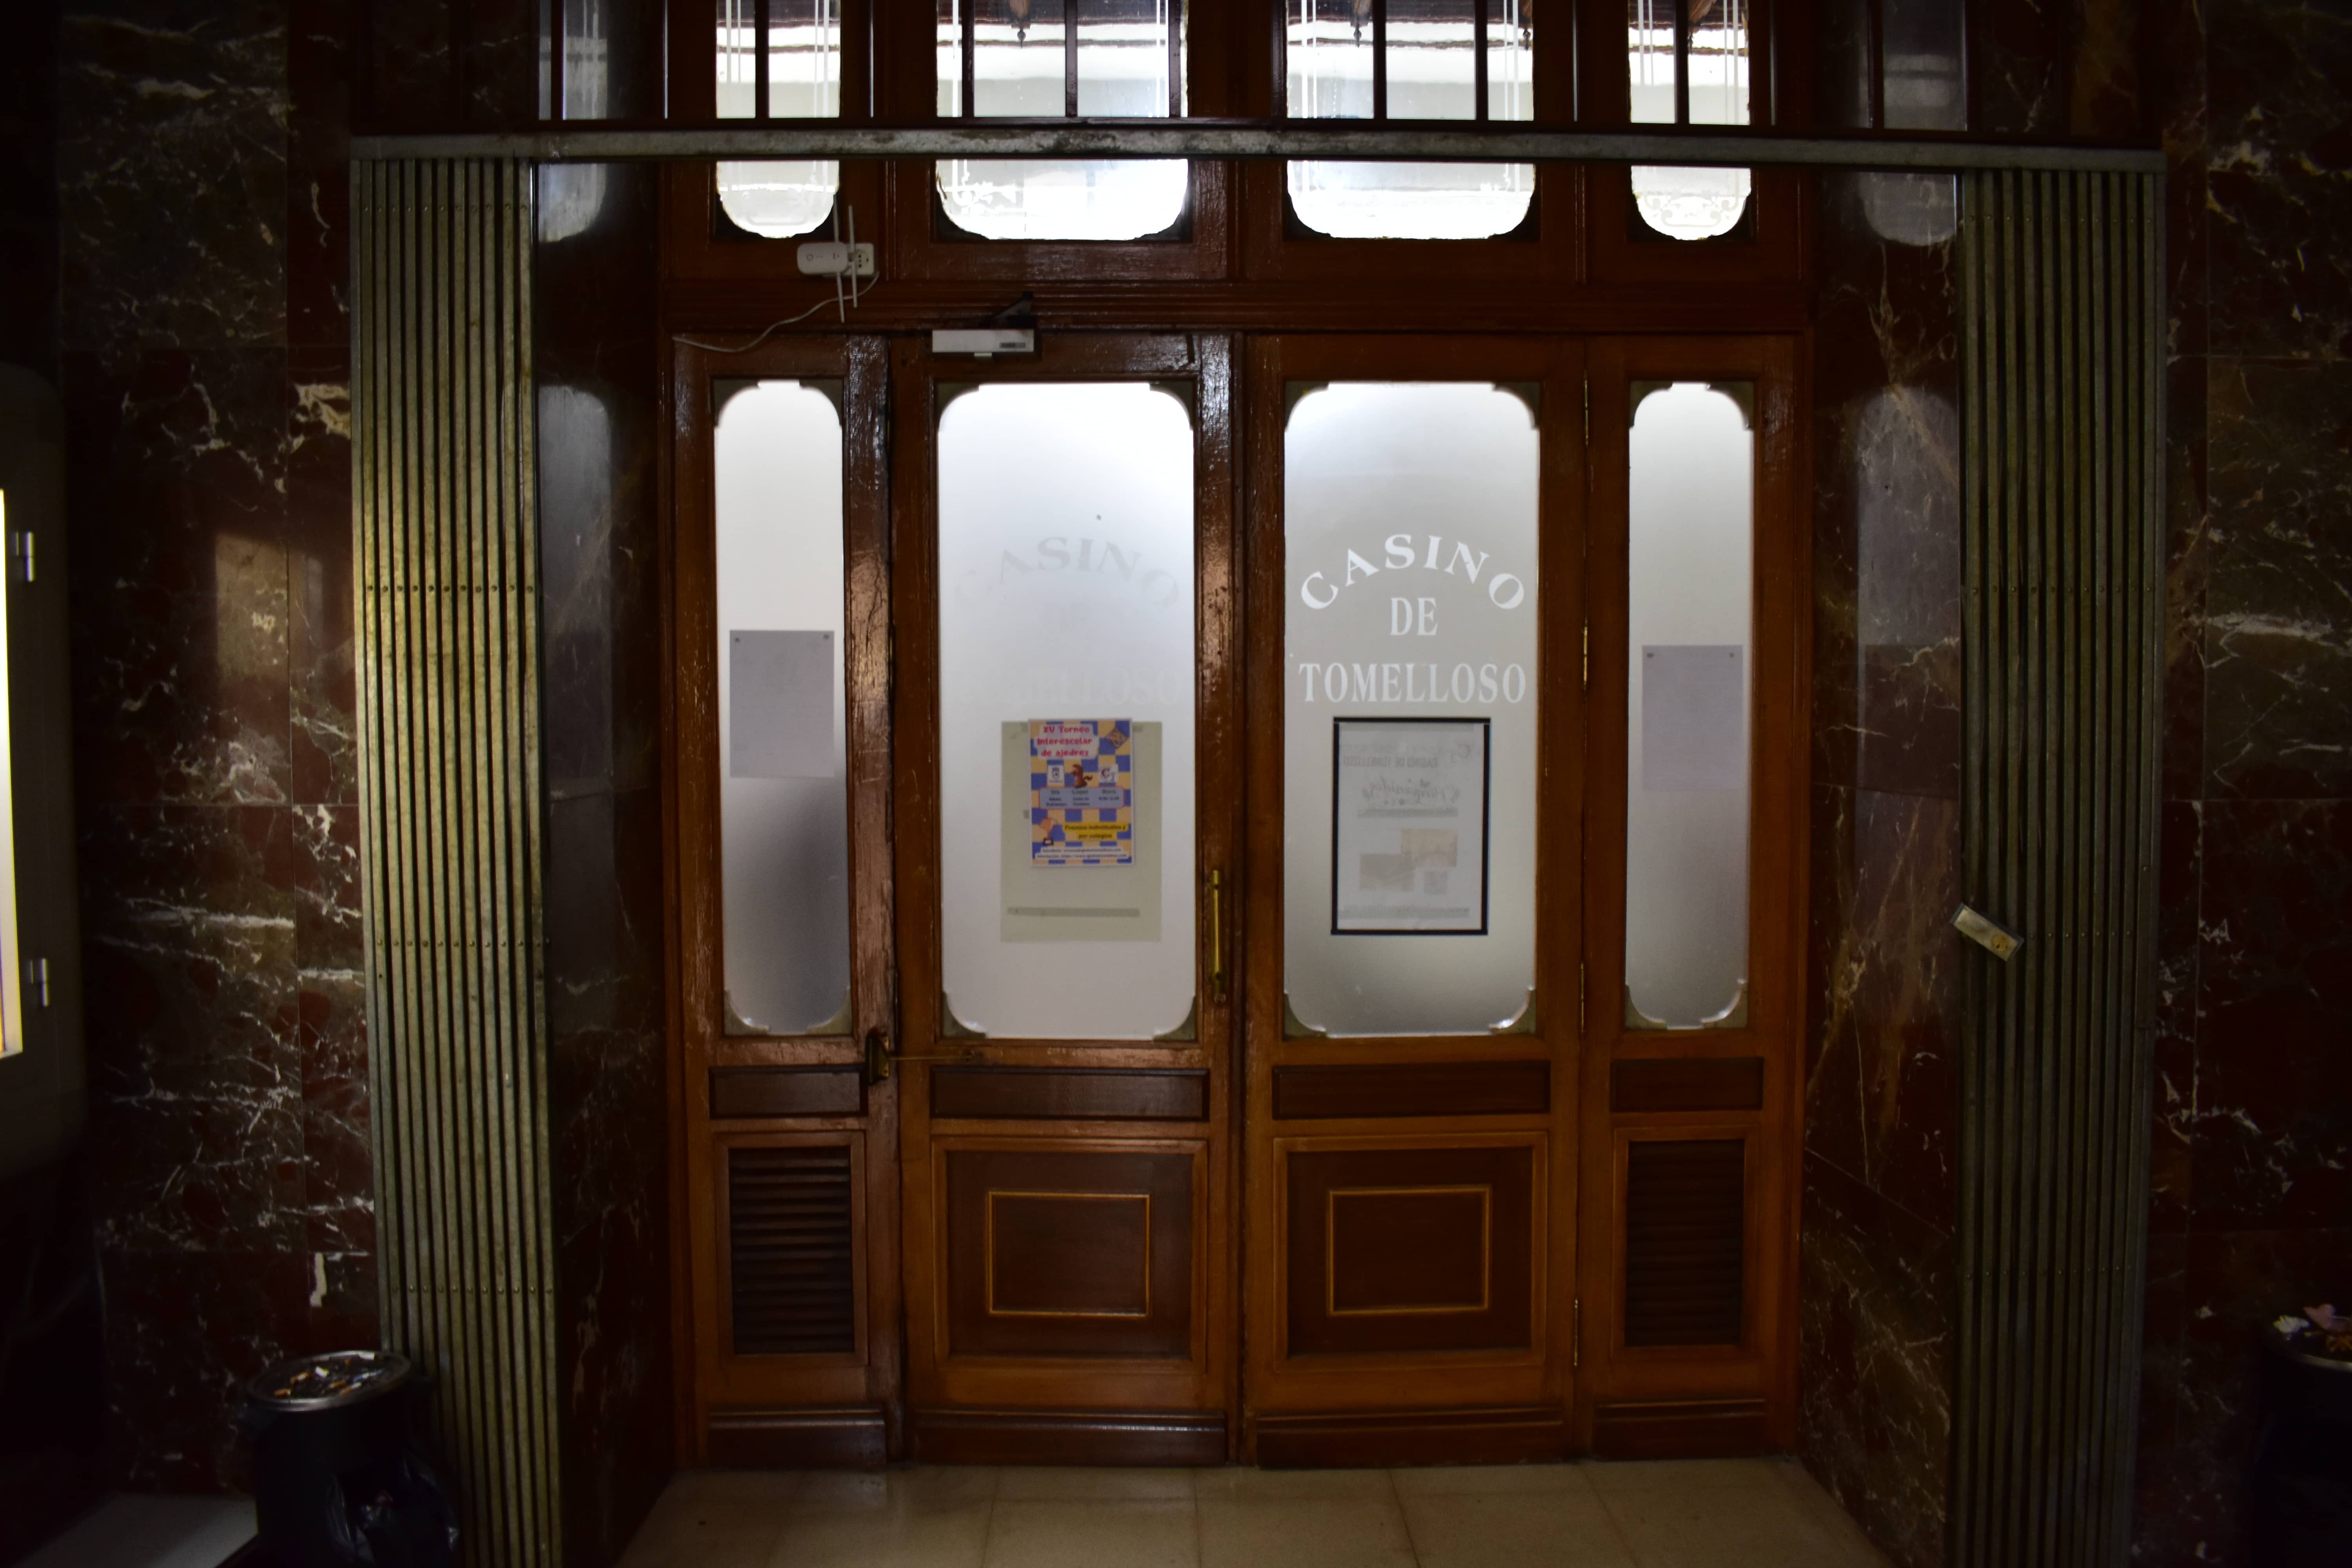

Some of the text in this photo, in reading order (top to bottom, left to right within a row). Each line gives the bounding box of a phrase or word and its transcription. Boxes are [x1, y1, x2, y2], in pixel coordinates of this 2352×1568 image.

[955, 537, 1180, 607] CASINO
[1301, 534, 1525, 610] CASINO
[1390, 597, 1438, 636] DE
[1299, 662, 1526, 703] TOMELLOSO
[1056, 749, 1089, 758] ajedrez
